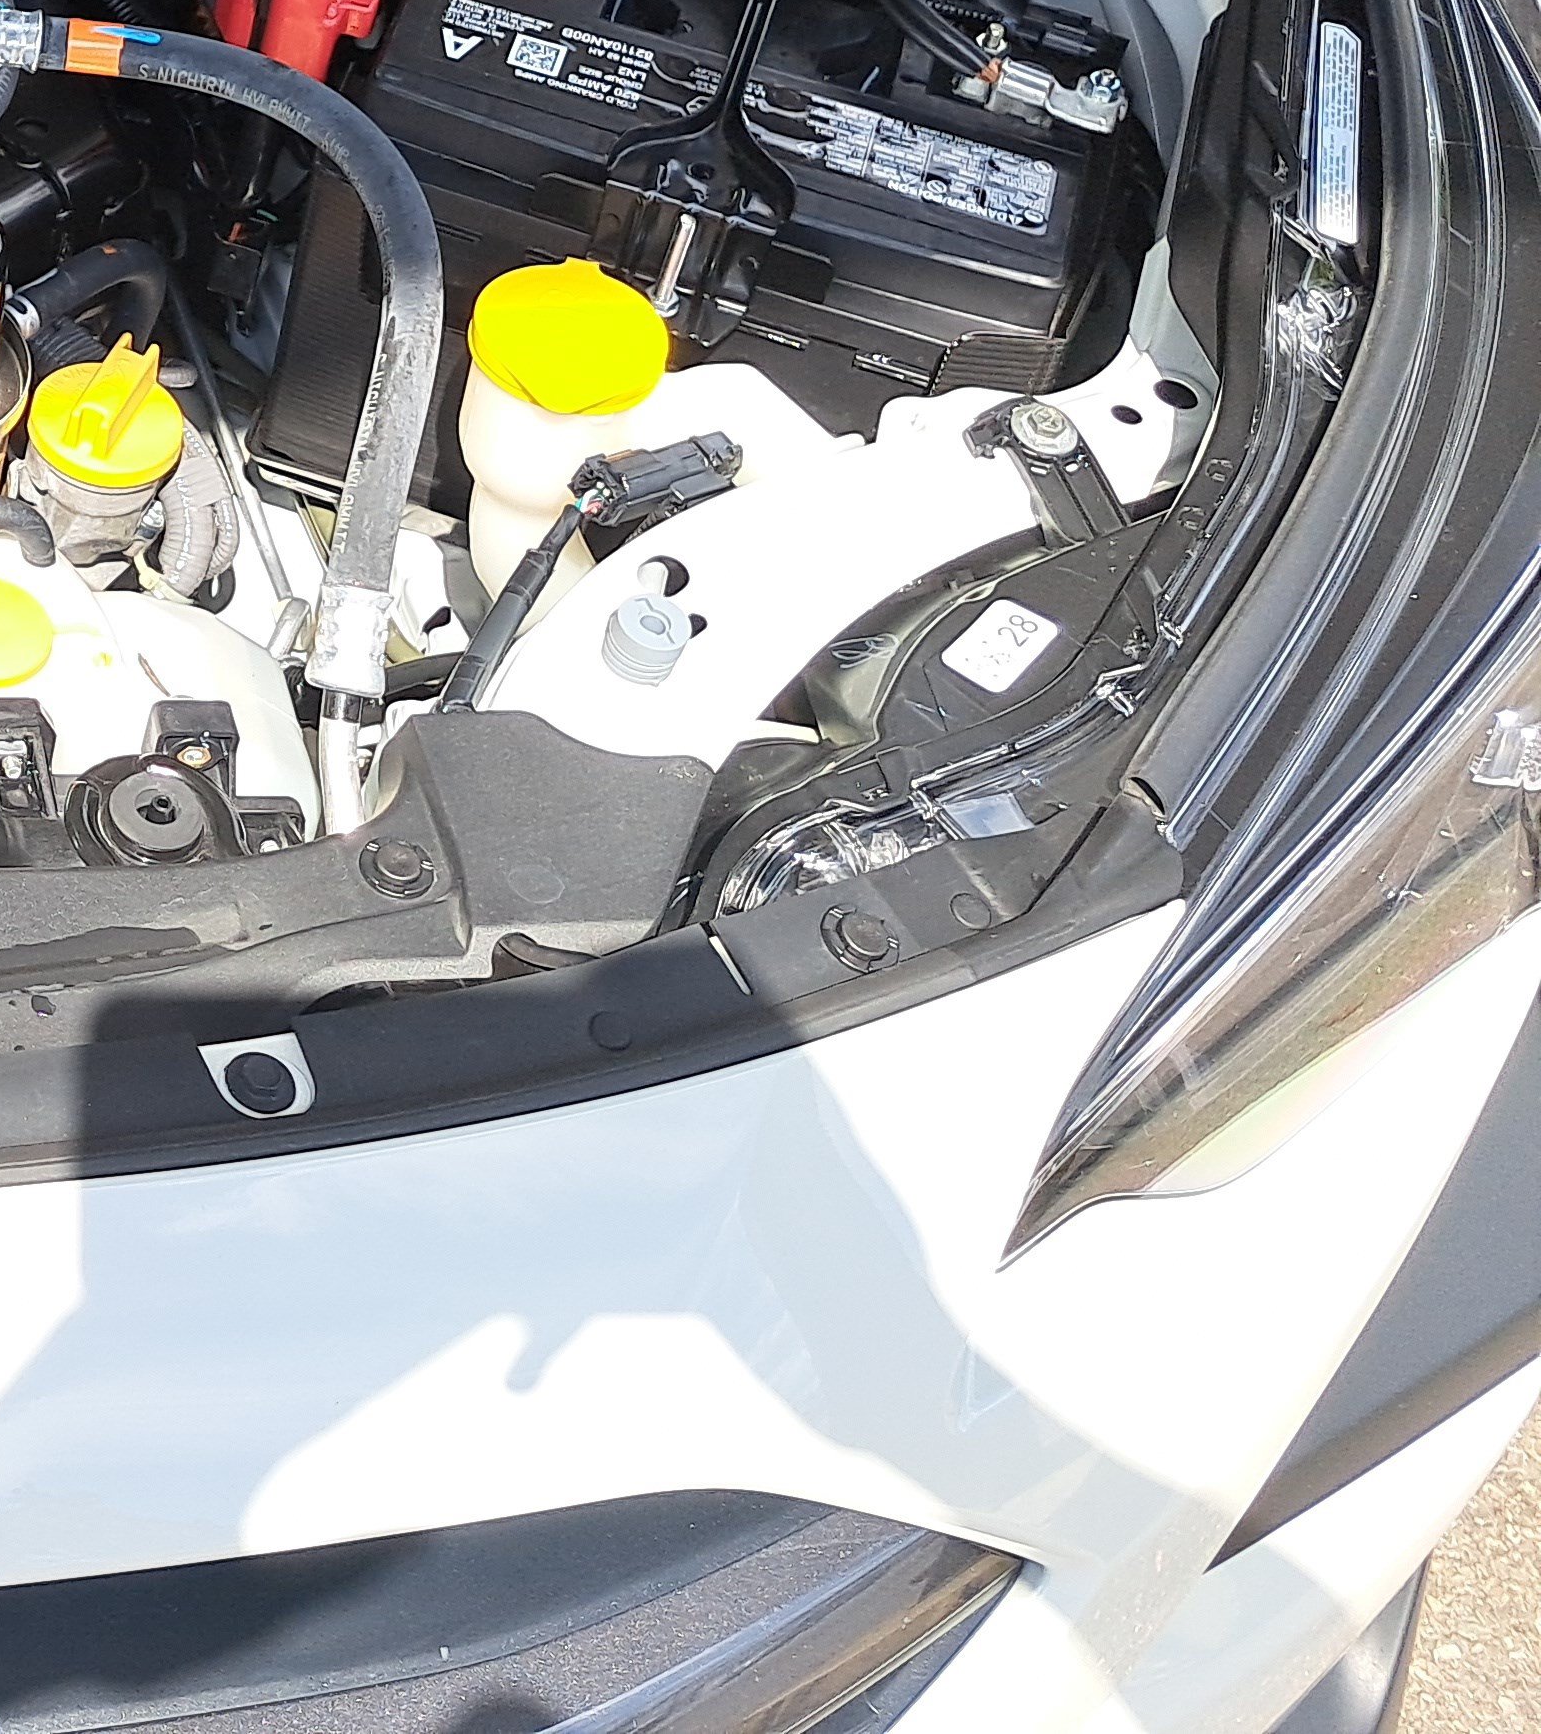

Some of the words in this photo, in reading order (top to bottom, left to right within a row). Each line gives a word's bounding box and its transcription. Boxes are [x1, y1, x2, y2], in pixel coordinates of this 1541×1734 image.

[441, 26, 484, 64] A
[567, 73, 611, 94] AMPS
[605, 95, 637, 111] COLD
[998, 615, 1038, 647] 28
